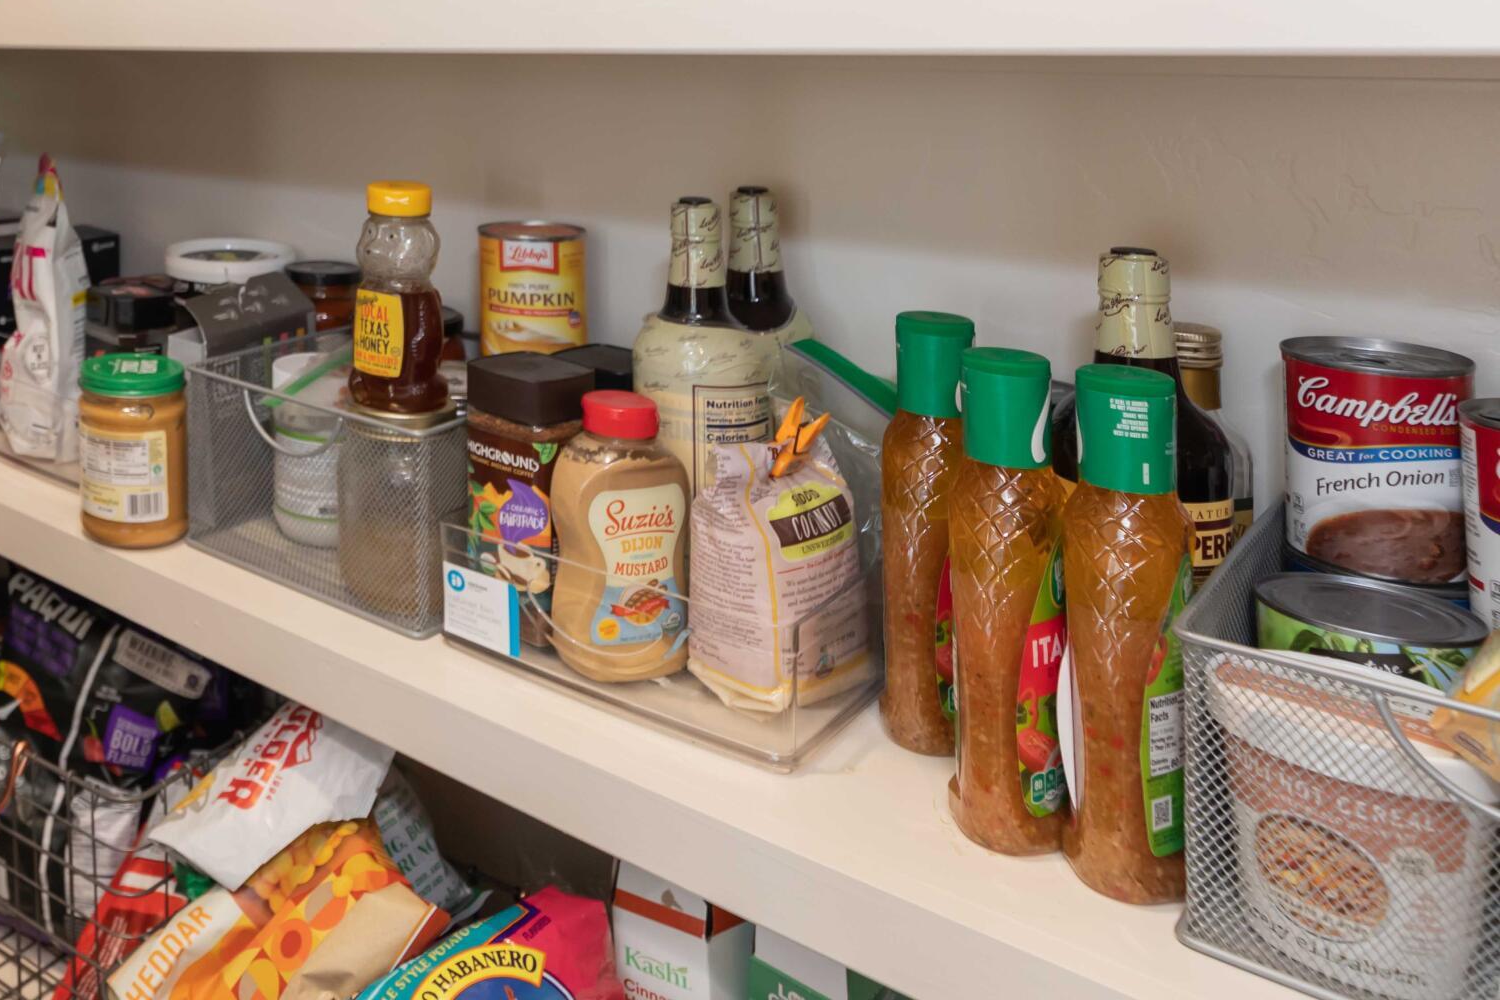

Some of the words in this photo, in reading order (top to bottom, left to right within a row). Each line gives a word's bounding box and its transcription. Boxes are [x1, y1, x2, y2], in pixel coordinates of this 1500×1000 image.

[510, 245, 548, 262] Libby's
[488, 288, 575, 306] PUMPKIN
[361, 302, 389, 321] LOCAL
[360, 318, 389, 338] TEXAS
[360, 336, 390, 354] HONEY
[706, 399, 752, 410] Nutrition
[1297, 375, 1459, 428] Campbell's
[706, 433, 749, 444] Calories
[1372, 424, 1437, 436] CONDENSED
[467, 440, 540, 473] HIGHGROUND
[1307, 447, 1356, 462] GREAT
[1359, 450, 1375, 460] for
[1378, 448, 1453, 461] COOKING
[1316, 472, 1380, 496] French
[1386, 470, 1445, 486] Onion
[500, 511, 546, 530] FAIRTRADE
[605, 499, 675, 536] Suzie's
[621, 536, 664, 553] DIJON
[614, 556, 668, 577] MUSTARD
[8, 571, 95, 641] PAQUI
[1150, 696, 1178, 709] Nutrition
[1150, 711, 1169, 722] Facts
[111, 729, 151, 755] BOLD
[1335, 796, 1438, 836] CEREAL
[124, 904, 213, 1000] HEDDAR
[398, 958, 432, 990] STYLE
[429, 926, 471, 960] POTATO
[433, 949, 538, 989] HABANERO
[624, 945, 691, 989] Kashi
